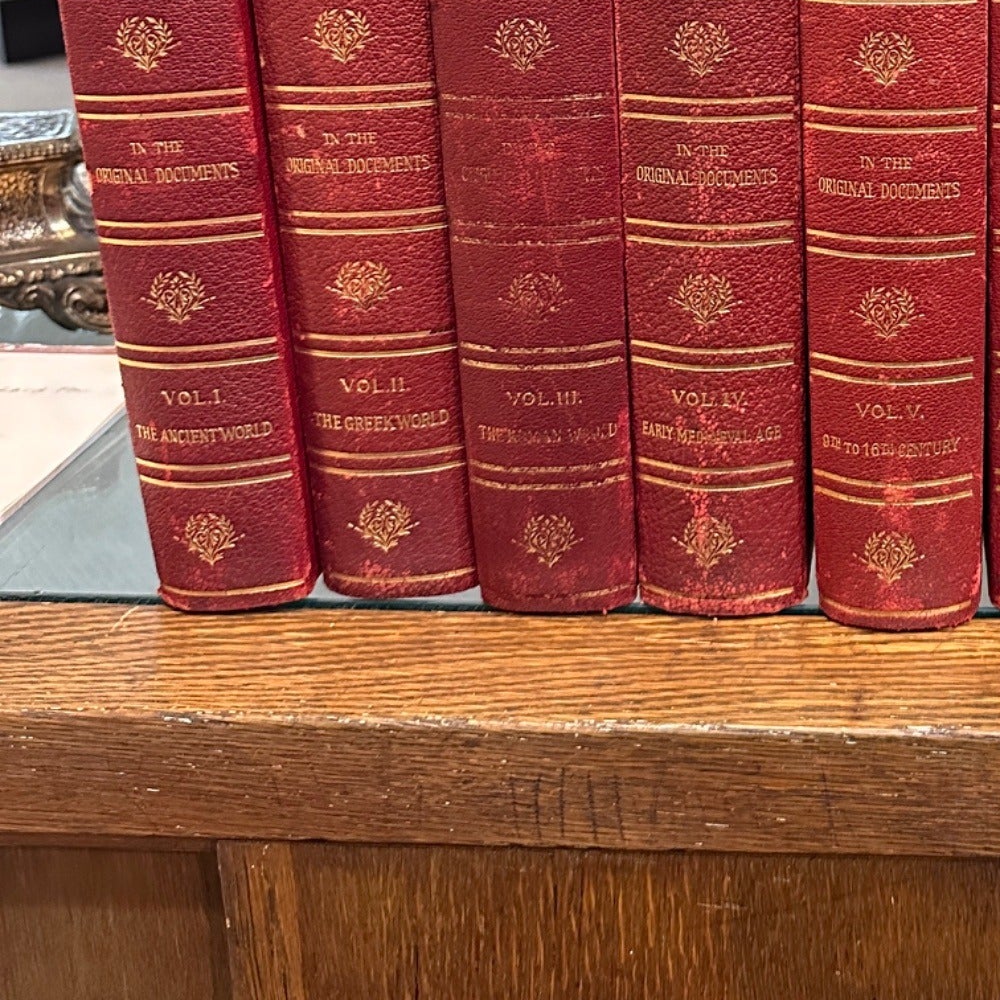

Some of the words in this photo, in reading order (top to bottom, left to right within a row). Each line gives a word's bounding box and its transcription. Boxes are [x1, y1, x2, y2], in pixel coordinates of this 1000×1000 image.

[130, 142, 147, 155] IN
[154, 140, 185, 153] THE
[323, 133, 340, 145] IN
[346, 132, 377, 144] THE
[676, 143, 692, 156] IN
[700, 144, 729, 157] THE
[287, 158, 342, 175] ORIGINAL
[347, 154, 430, 173] DOCUMENTS
[860, 155, 875, 169] IN
[882, 157, 913, 169] THE
[96, 168, 151, 184] ORIGINAL
[155, 162, 239, 184] DOCUMENTS
[636, 165, 693, 184] ORIGINAL
[699, 168, 778, 187] DOCUMENTS
[818, 177, 875, 198] ORIGINAL
[881, 182, 960, 200] DOCUMENTS
[313, 411, 342, 430] THE
[344, 415, 397, 431] GREEK
[395, 409, 450, 430] WORLD
[135, 424, 159, 441] THE
[161, 427, 217, 443] ANCIENT
[218, 421, 273, 441] WORLD
[642, 420, 674, 440] EARLY
[756, 425, 782, 442] AGE
[843, 442, 860, 455] TO
[898, 437, 961, 457] CENTURY
